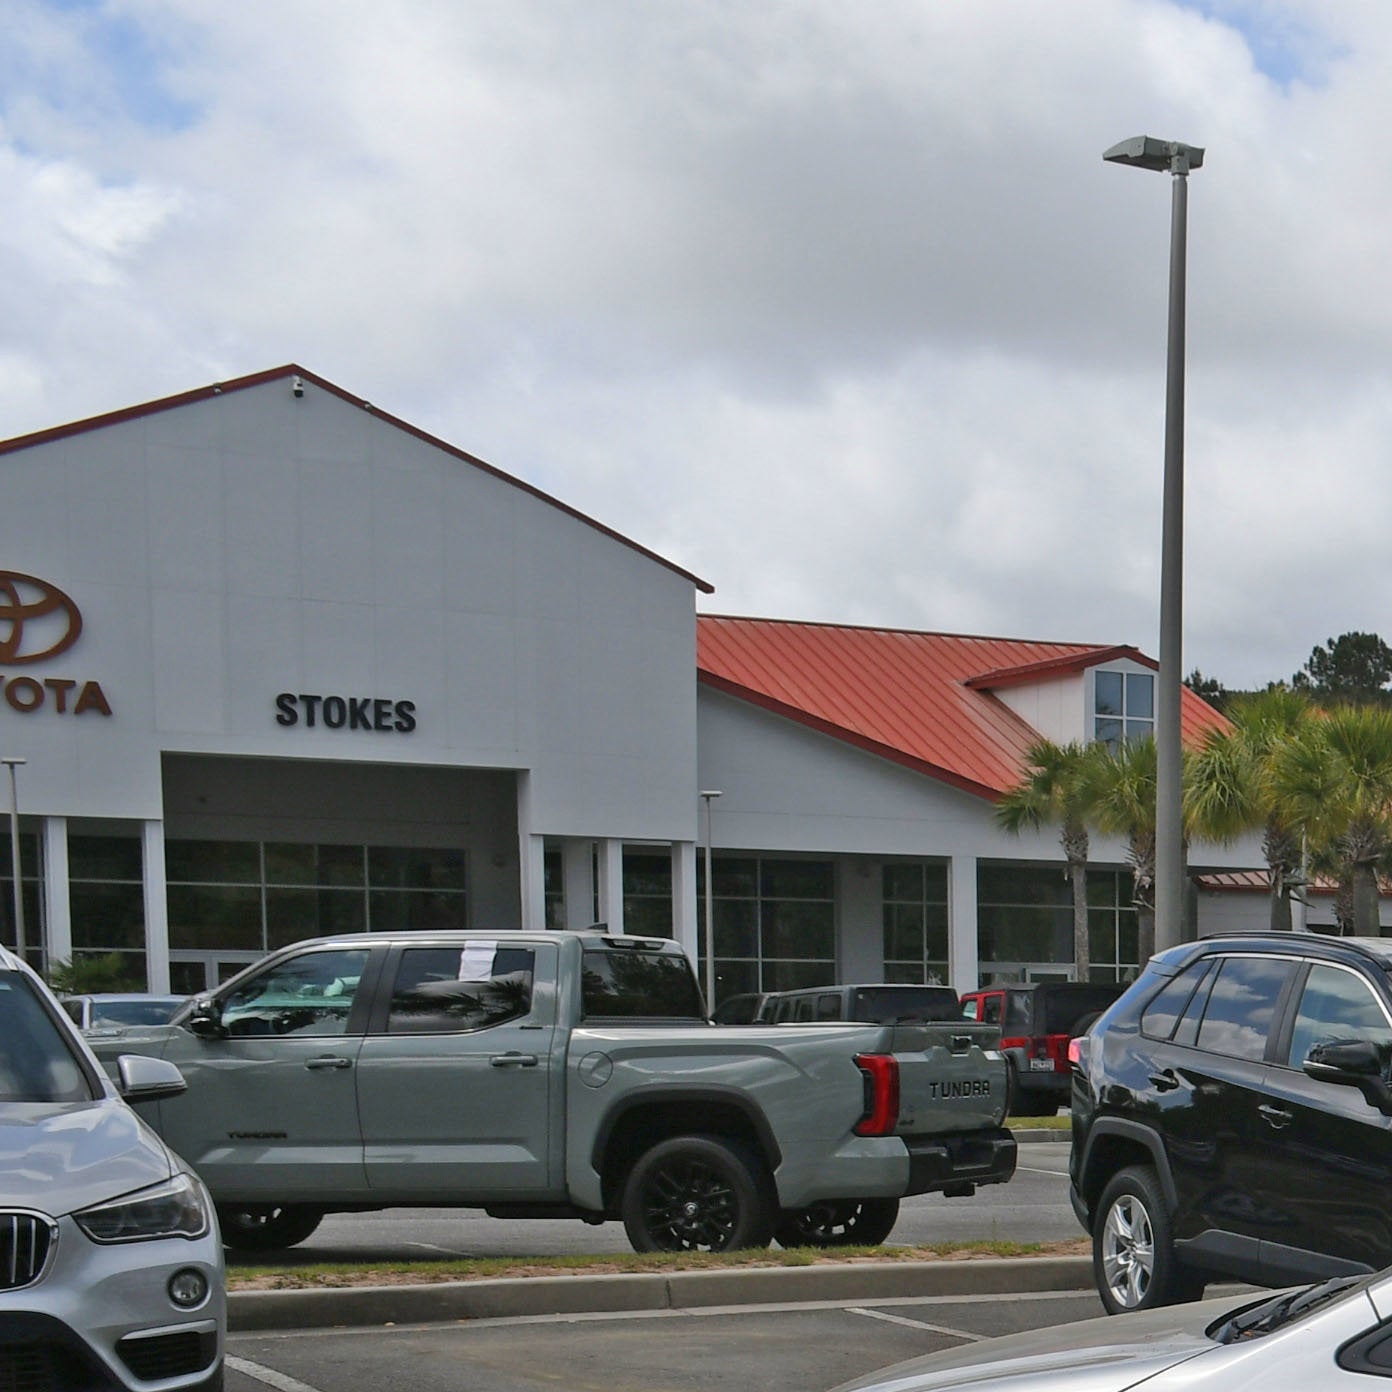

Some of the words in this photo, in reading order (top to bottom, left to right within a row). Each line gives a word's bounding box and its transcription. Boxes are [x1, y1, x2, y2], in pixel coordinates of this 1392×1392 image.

[0, 675, 113, 716] OTA
[276, 693, 416, 732] STOKES
[929, 1080, 991, 1099] TUNDRA
